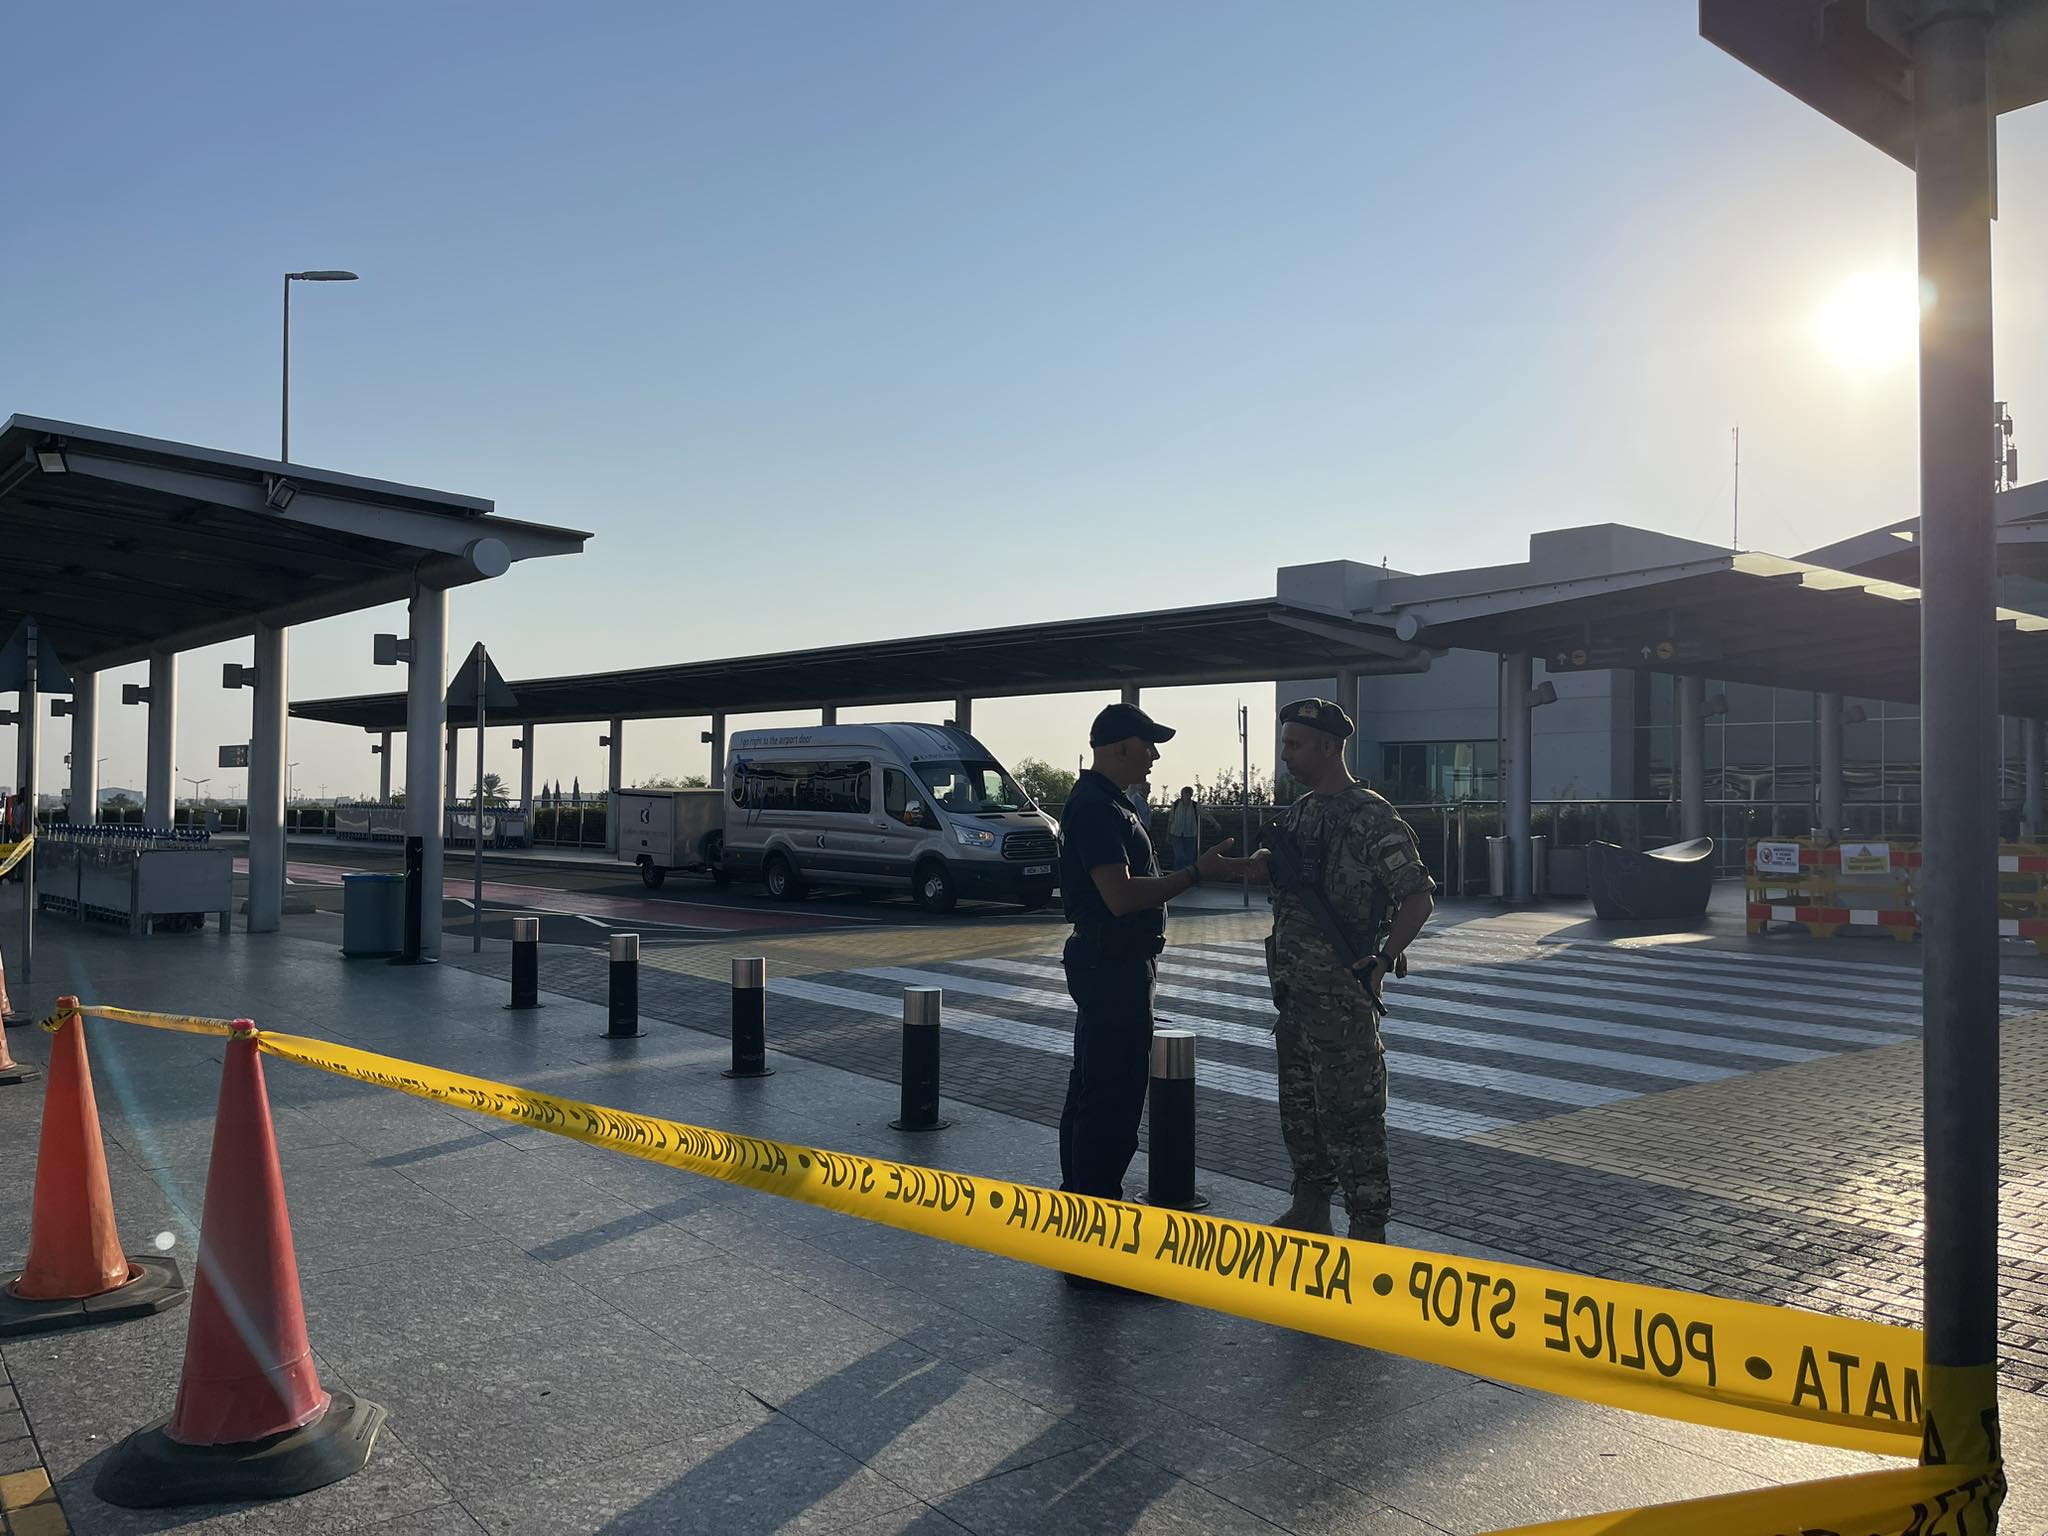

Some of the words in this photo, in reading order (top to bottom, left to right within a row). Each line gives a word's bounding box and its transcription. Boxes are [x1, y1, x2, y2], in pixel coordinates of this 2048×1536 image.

[743, 738, 750, 748] go
[750, 736, 762, 748] right
[770, 735, 778, 745] the
[779, 735, 798, 746] airport
[799, 733, 812, 744] door
